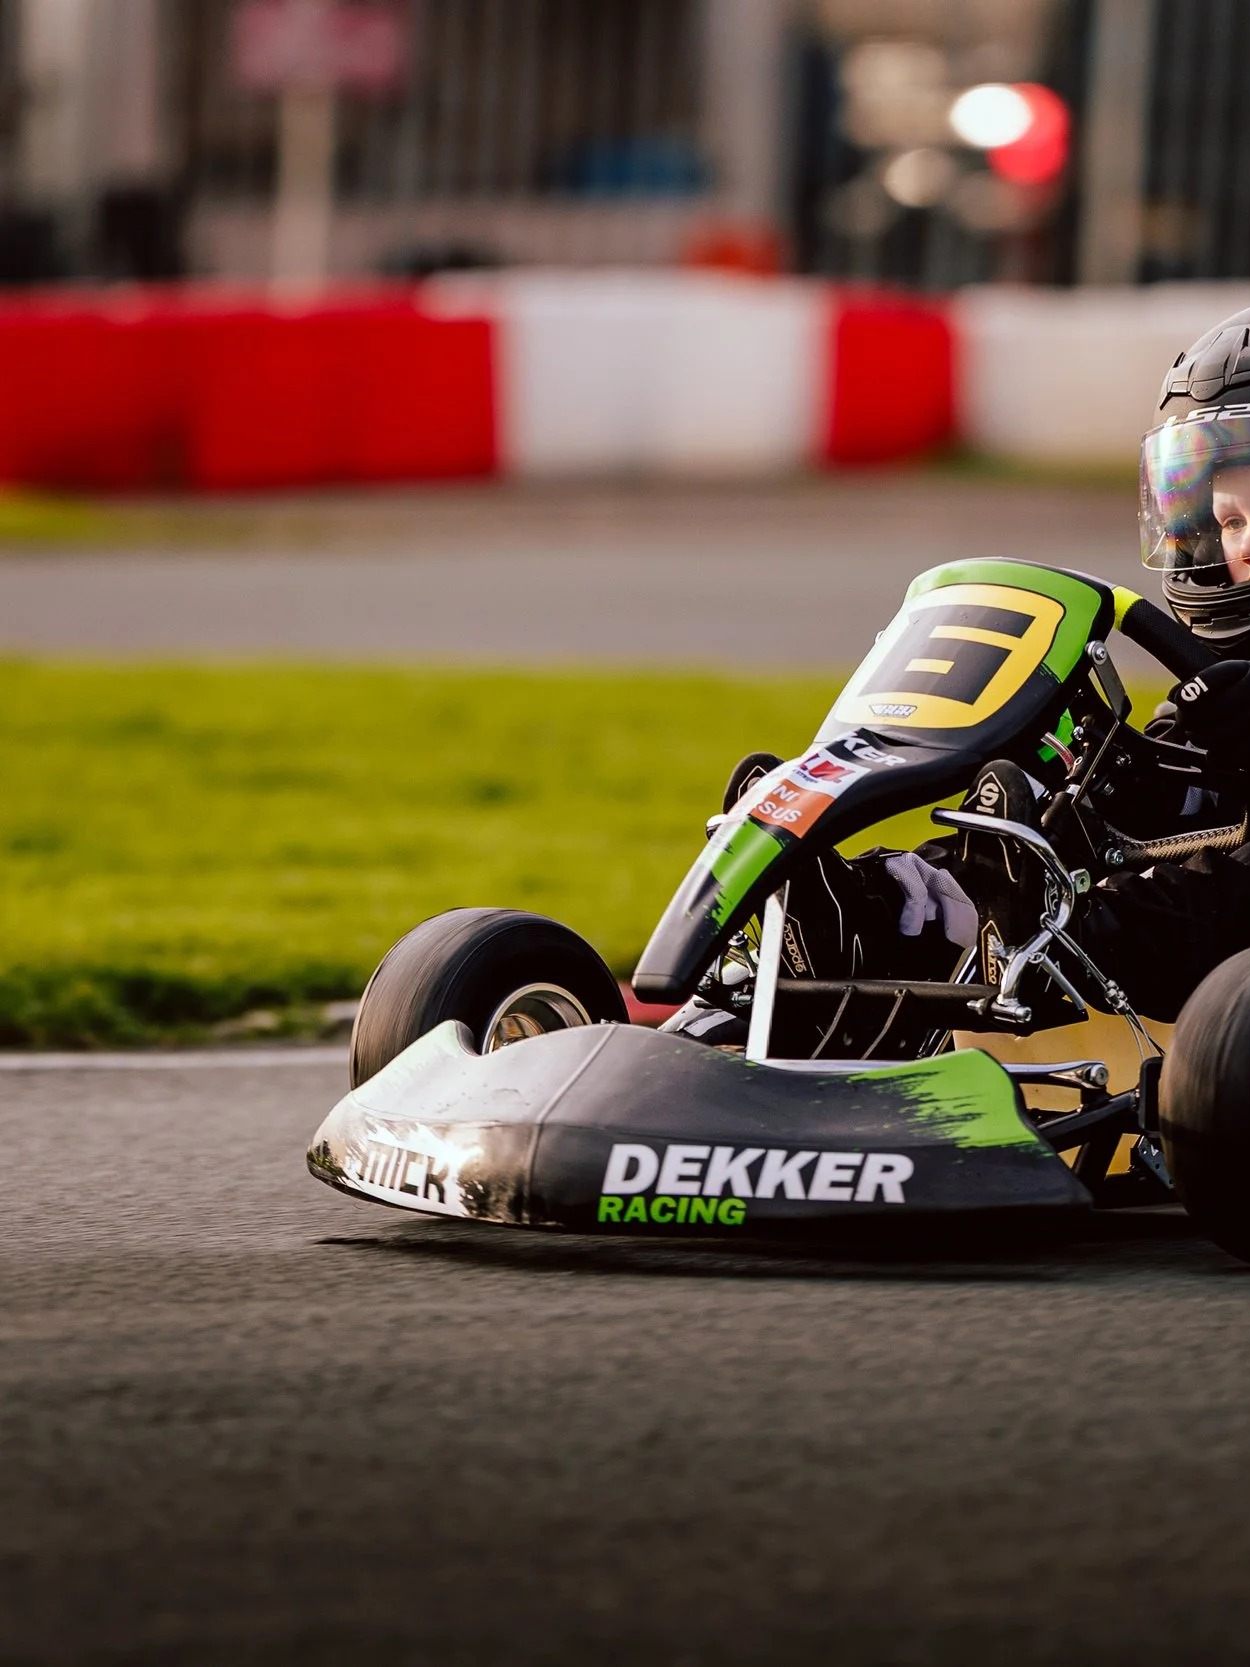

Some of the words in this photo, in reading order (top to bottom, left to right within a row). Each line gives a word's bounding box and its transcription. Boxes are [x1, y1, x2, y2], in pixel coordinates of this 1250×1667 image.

[857, 604, 1036, 706] 6
[758, 802, 803, 824] SUS
[602, 1144, 914, 1203] DEKKER
[599, 1196, 747, 1225] RACING
